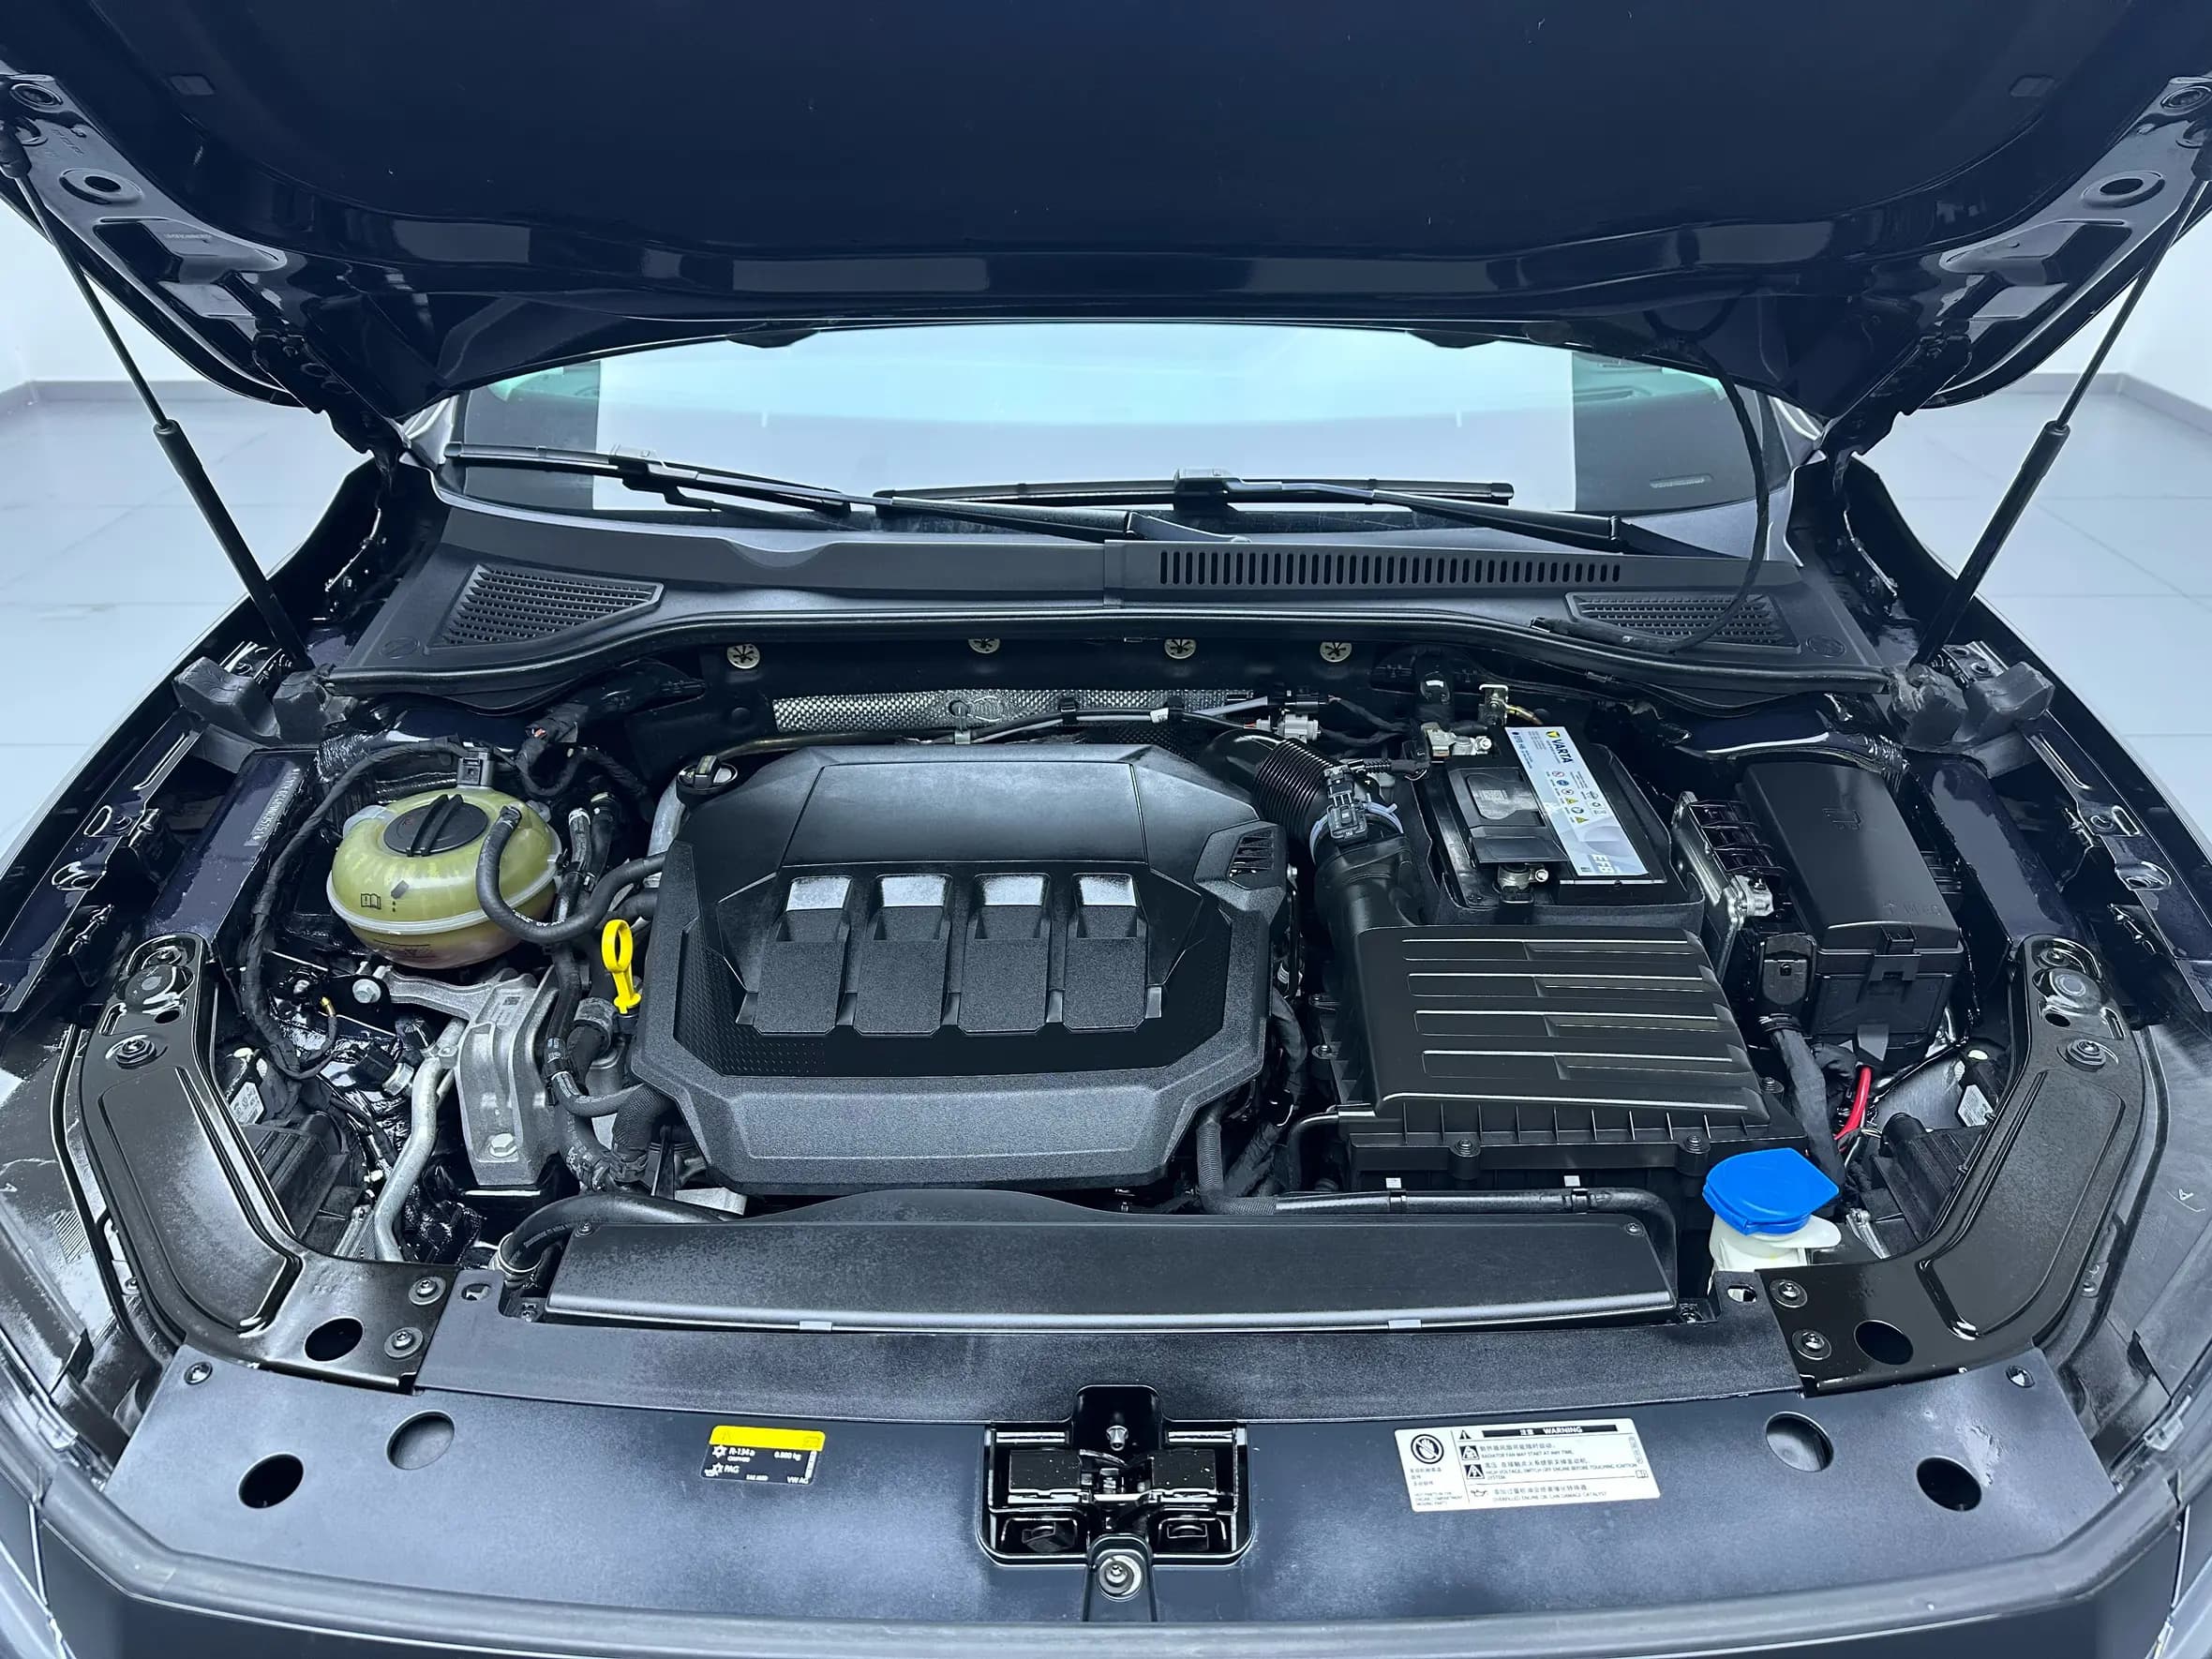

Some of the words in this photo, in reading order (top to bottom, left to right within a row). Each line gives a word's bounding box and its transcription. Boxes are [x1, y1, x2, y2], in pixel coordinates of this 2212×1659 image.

[1551, 739, 1574, 764] VARTA
[1592, 854, 1615, 874] EFB
[1543, 1426, 1583, 1435] WARNING
[724, 1464, 740, 1473] PAG
